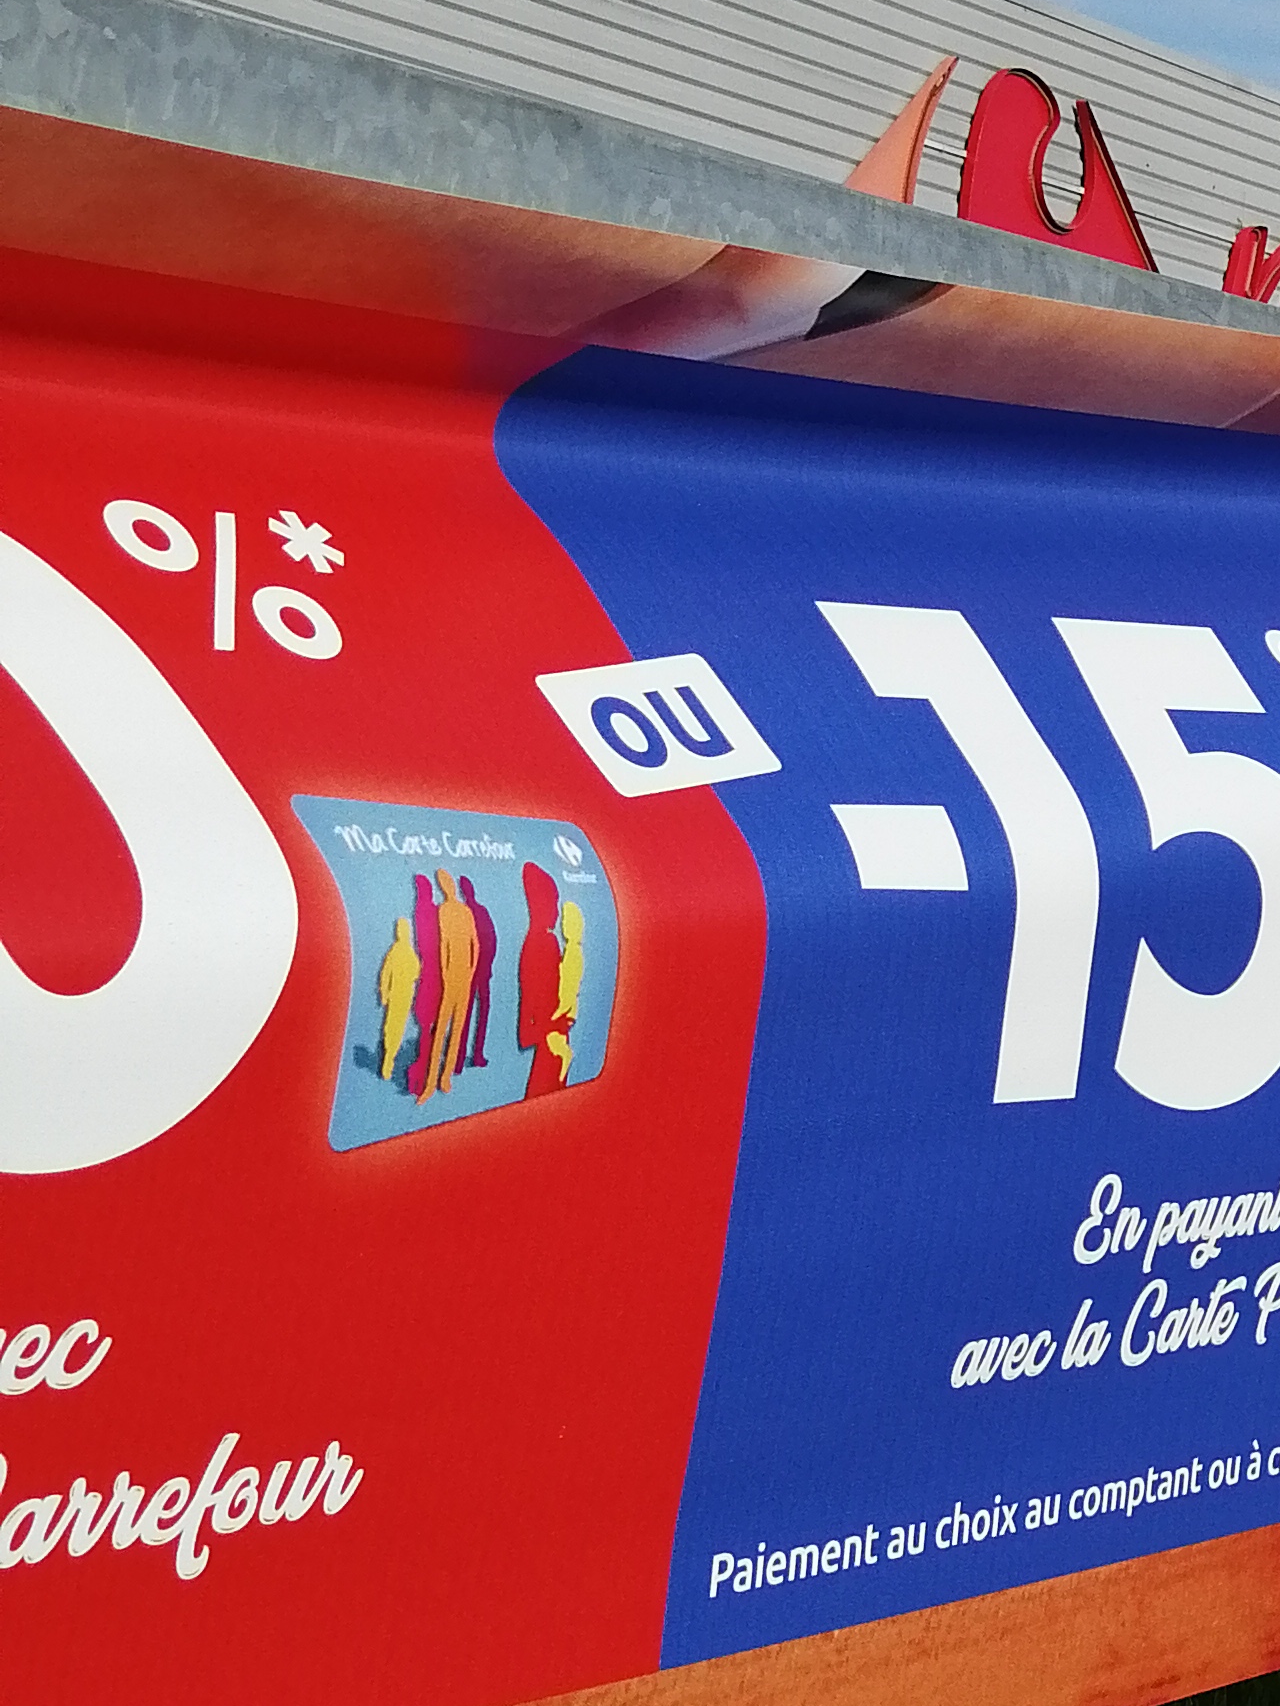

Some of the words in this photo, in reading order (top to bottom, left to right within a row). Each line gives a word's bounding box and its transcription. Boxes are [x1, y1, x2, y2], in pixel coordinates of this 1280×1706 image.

[334, 824, 388, 853] Ma
[1072, 1172, 1147, 1266] En
[0, 1318, 112, 1395] ec
[950, 1330, 1060, 1389] avec
[1061, 1299, 1108, 1369] la
[1121, 1276, 1247, 1369] Carte
[0, 1432, 364, 1580] arrefour
[707, 1528, 879, 1599] Paiement
[885, 1515, 926, 1555] au
[935, 1493, 1018, 1550] choix
[1023, 1495, 1061, 1528] au
[1067, 1456, 1202, 1522] comptant
[1207, 1459, 1243, 1490] ou
[1247, 1441, 1264, 1482] à
